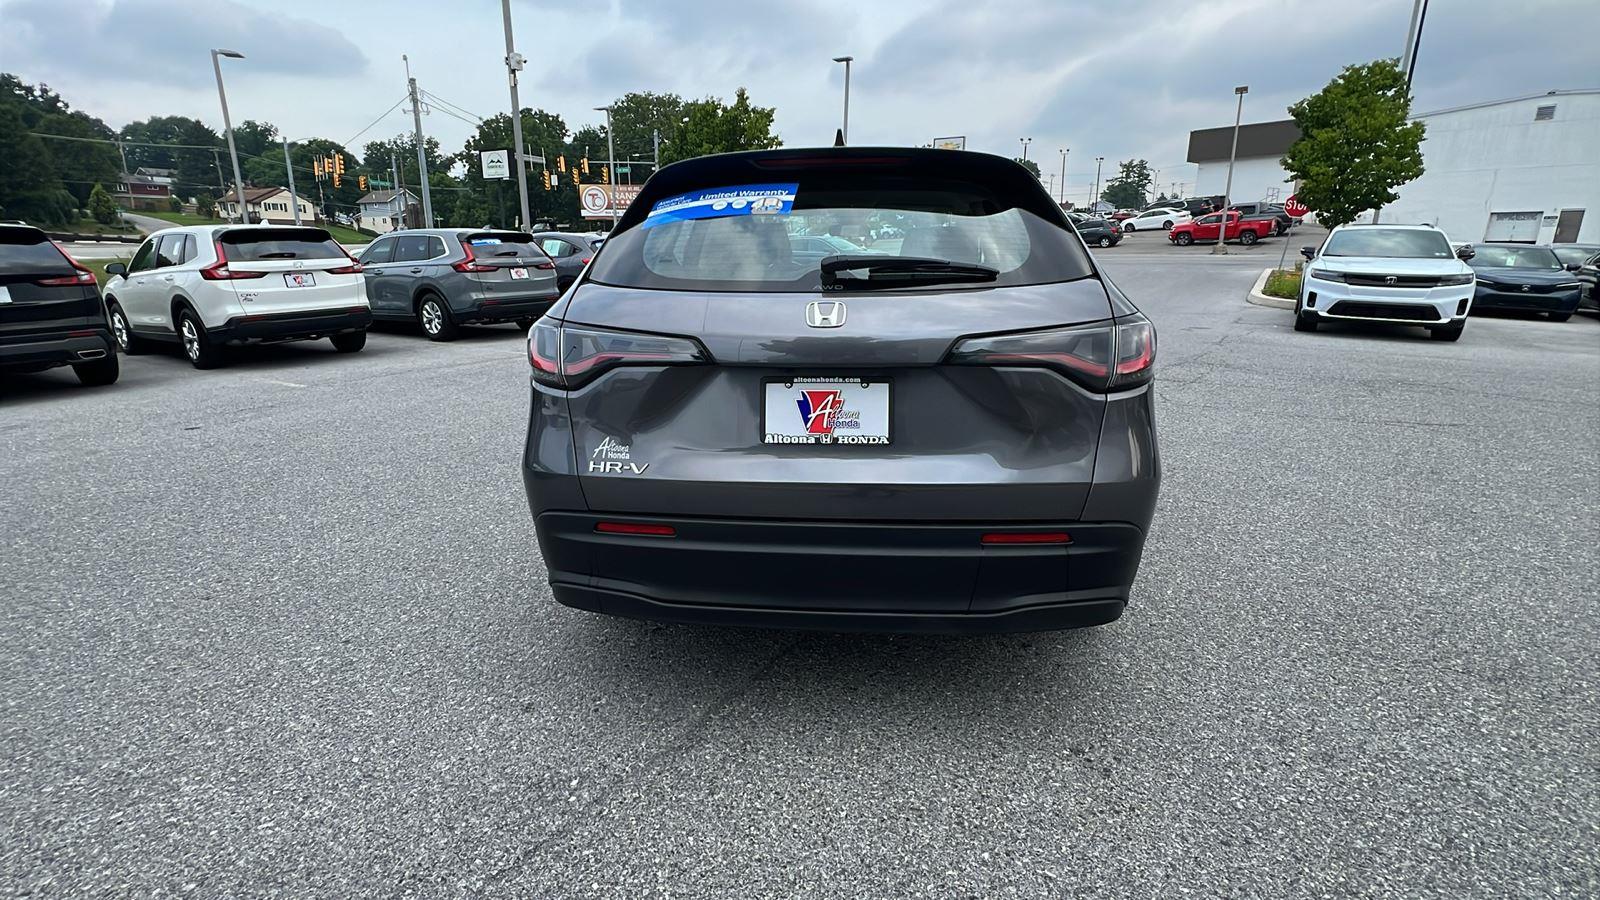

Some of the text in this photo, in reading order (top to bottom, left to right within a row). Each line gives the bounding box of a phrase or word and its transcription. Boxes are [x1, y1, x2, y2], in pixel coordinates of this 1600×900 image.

[700, 189, 789, 201] Limited Warranty
[828, 418, 860, 428] Honda
[764, 433, 816, 444] Altoona
[837, 436, 889, 444] HONDA
[607, 451, 630, 459] Honda
[588, 460, 650, 475] HR-V
